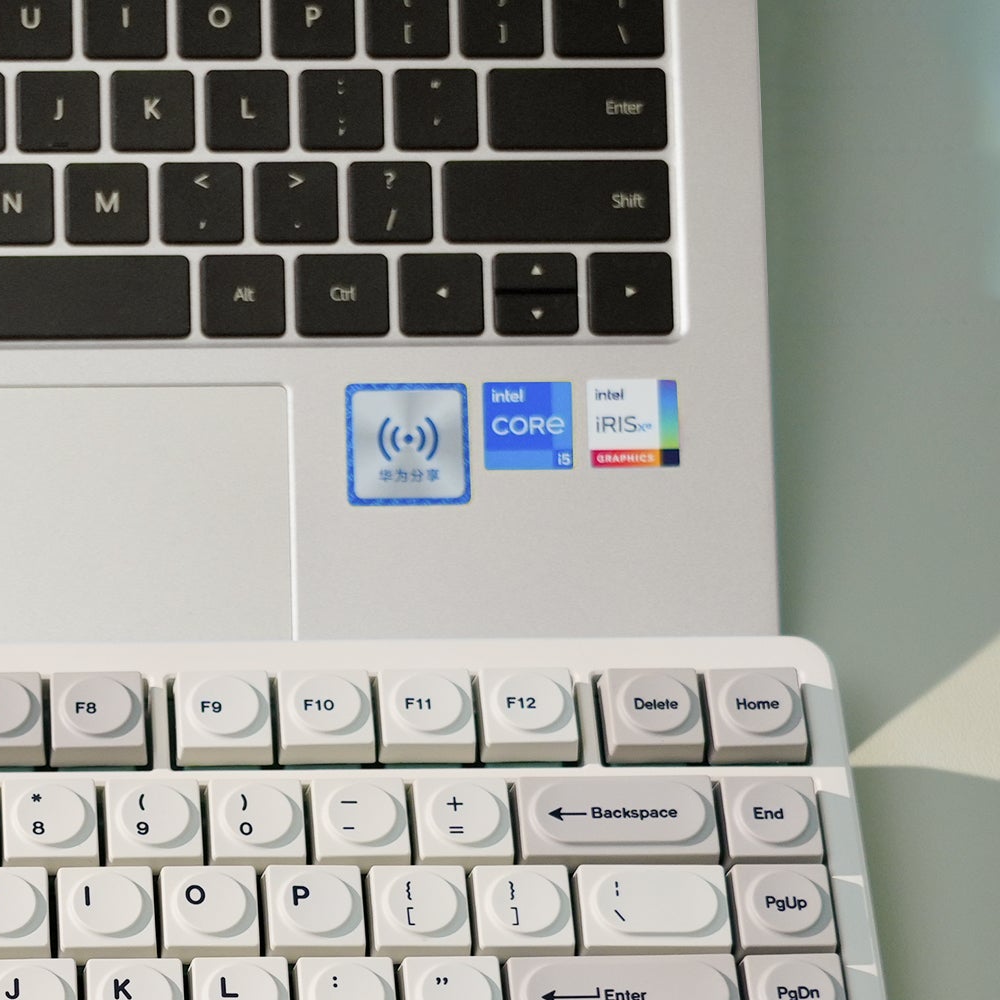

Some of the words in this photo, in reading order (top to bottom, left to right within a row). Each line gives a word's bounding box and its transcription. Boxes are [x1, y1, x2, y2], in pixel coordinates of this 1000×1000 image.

[21, 8, 40, 29] U
[122, 8, 128, 28] I
[209, 6, 231, 28] O
[306, 6, 321, 27] P
[54, 99, 63, 120] J
[144, 99, 160, 119] K
[241, 99, 255, 119] L
[606, 100, 643, 114] Enter
[3, 193, 22, 213] N
[96, 192, 119, 212] M
[612, 193, 644, 208] Shift
[234, 288, 254, 301] Alt
[330, 286, 355, 301] Ctrl
[491, 388, 524, 403] intel
[595, 388, 624, 401] intel
[491, 414, 565, 434] CORE
[556, 453, 571, 466] i5
[596, 454, 655, 463] GRAPHICS
[76, 702, 96, 714] F8
[201, 701, 221, 713] F9
[304, 700, 334, 710] F10
[406, 698, 431, 709] F11
[507, 697, 536, 708] F12
[634, 698, 678, 709] Delete
[736, 698, 779, 710] Home
[139, 794, 144, 810] (
[241, 794, 247, 811] )
[447, 797, 463, 811] +
[591, 807, 677, 820] Backspace
[753, 807, 783, 819] End
[33, 821, 44, 834] 8
[137, 822, 149, 835] 9
[240, 822, 252, 835] 0
[85, 886, 90, 906] I
[186, 885, 205, 904] O
[293, 886, 309, 906] P
[766, 896, 807, 911] PgUp
[5, 978, 19, 999] J
[114, 979, 132, 1000] K
[221, 977, 238, 997] L
